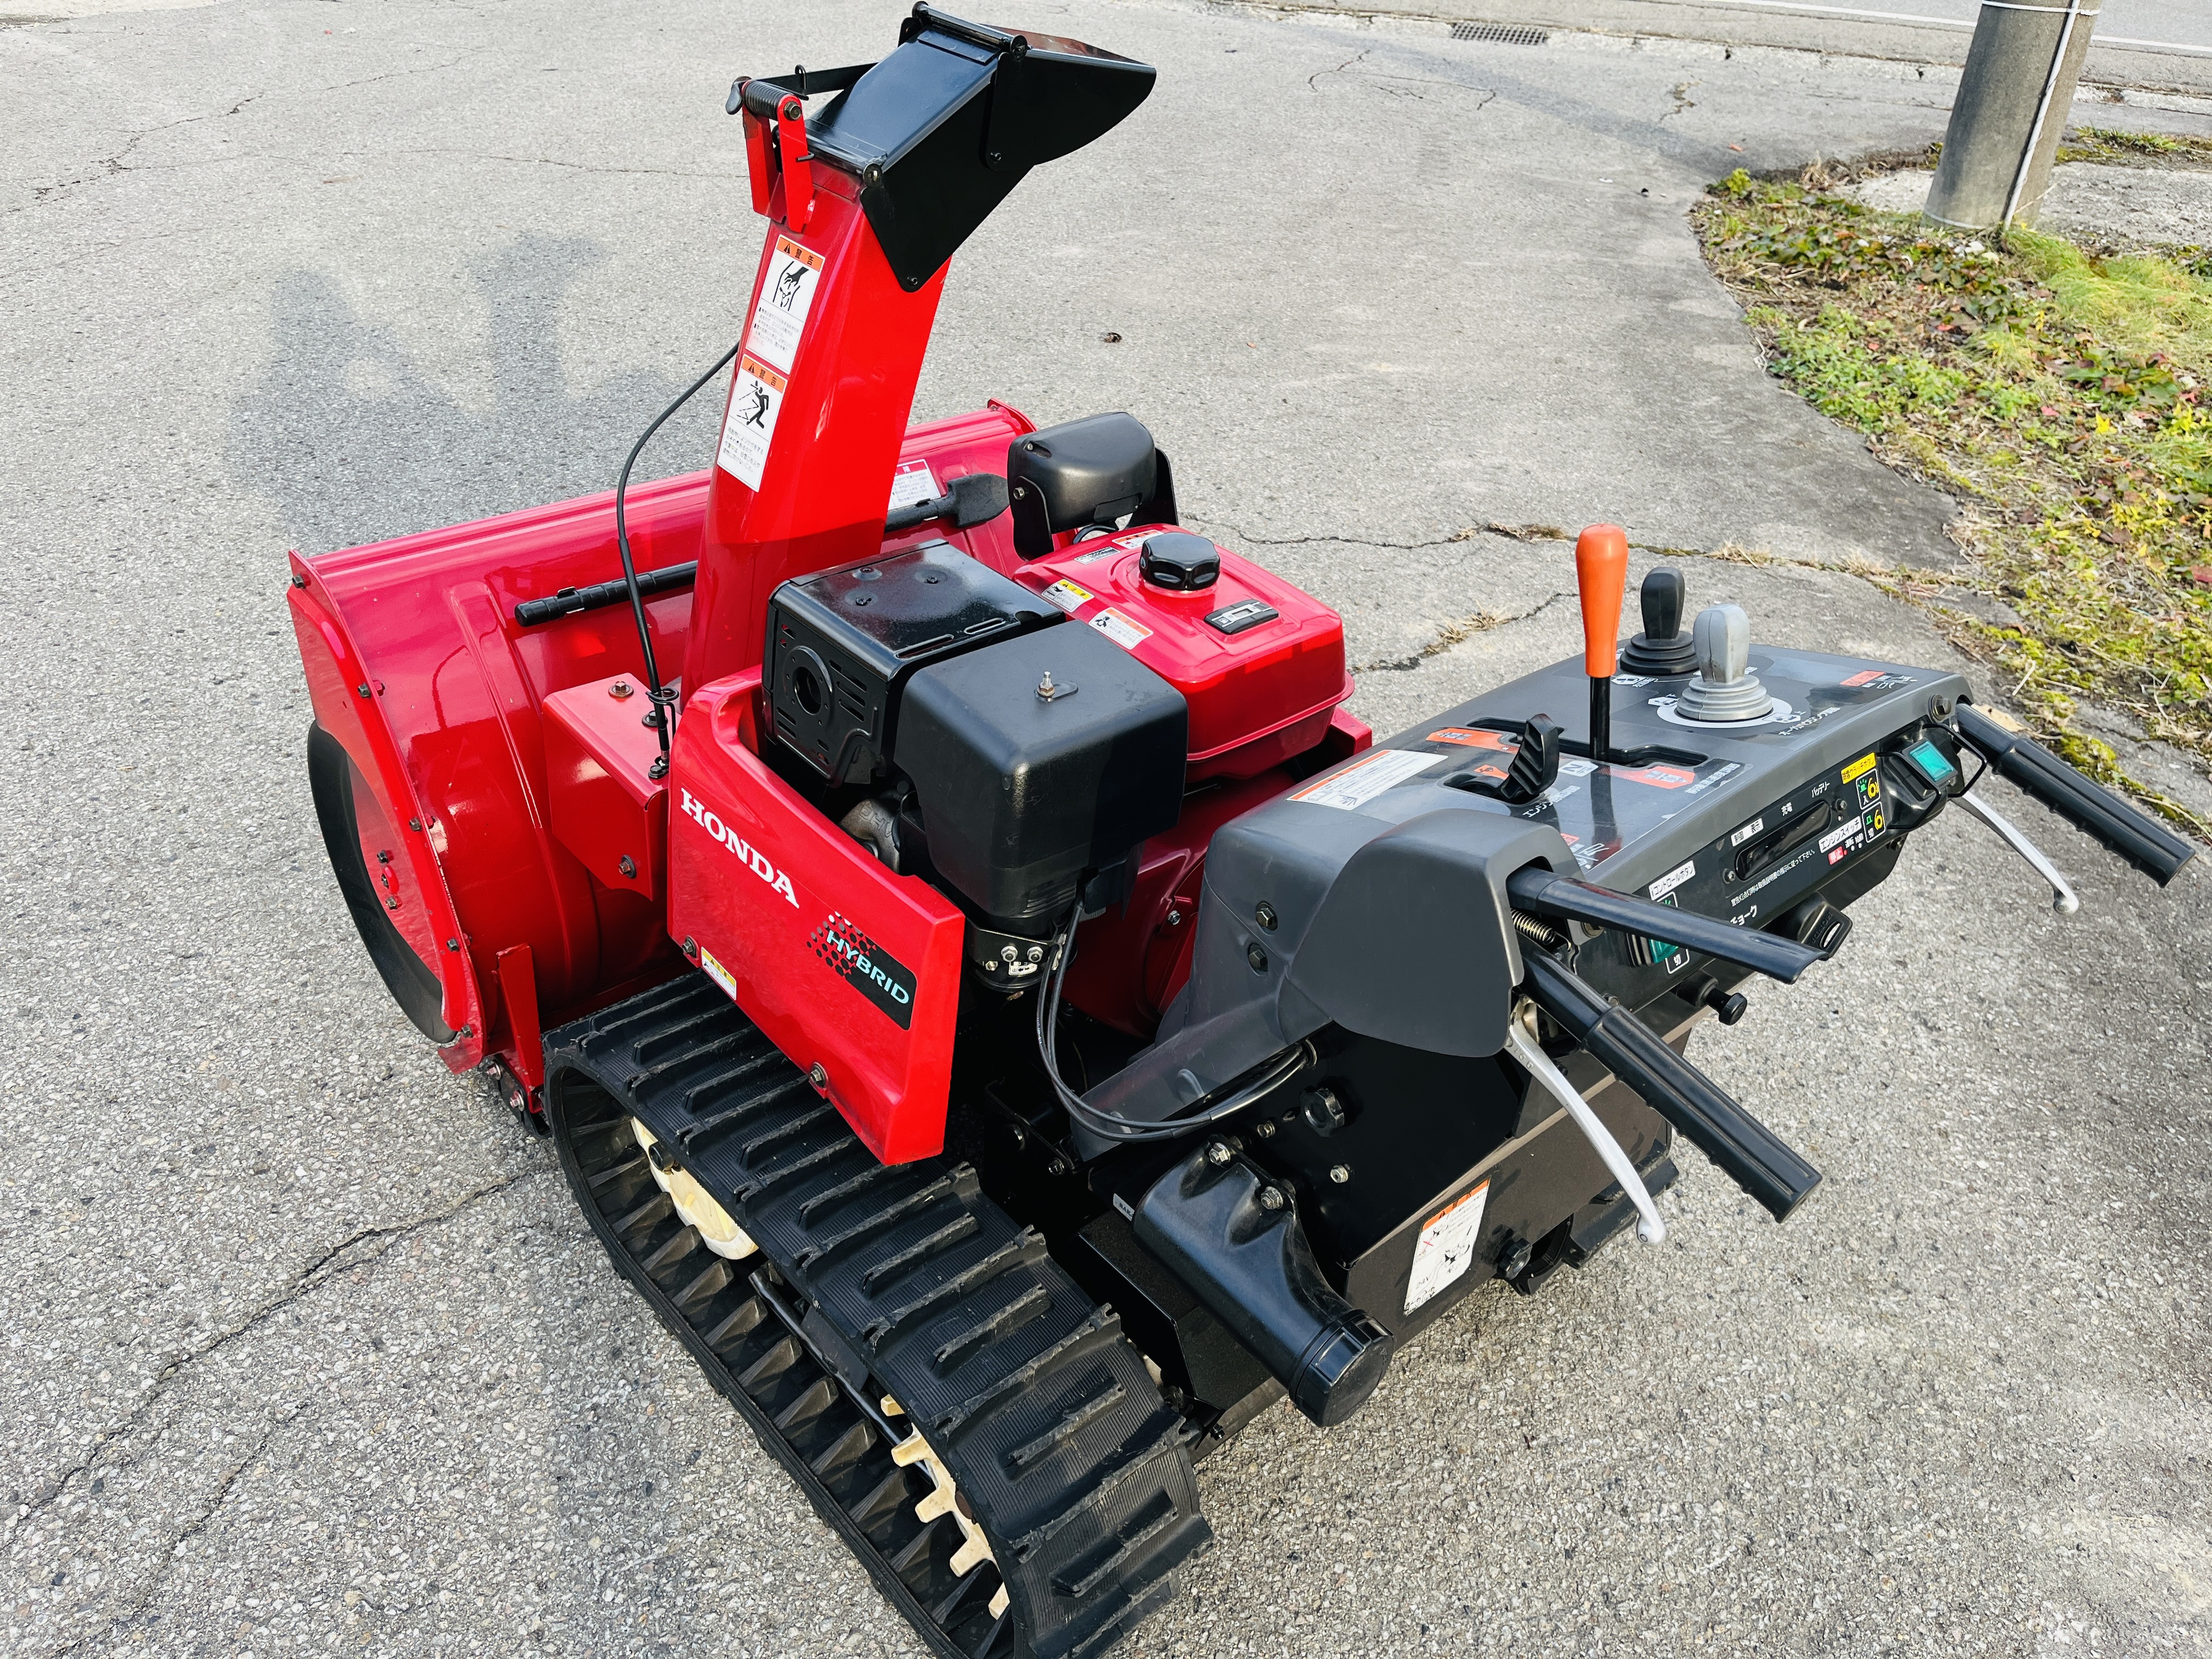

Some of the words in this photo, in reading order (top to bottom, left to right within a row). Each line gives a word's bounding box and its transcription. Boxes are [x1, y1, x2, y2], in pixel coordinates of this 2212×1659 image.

[794, 248, 814, 266] 警告
[759, 368, 777, 387] 警告
[1812, 781, 1830, 798] バッテリー
[1863, 795, 1869, 805] 入
[1781, 802, 1793, 816] 充電
[859, 805, 893, 838] OHV
[1820, 820, 1861, 850] エンジンスイッチ
[681, 787, 800, 909] HONDA
[1829, 848, 1843, 865] 停止
[827, 929, 910, 1005] HYBRID
[1673, 953, 1682, 966] 切
[1415, 1276, 1430, 1289] 24V
